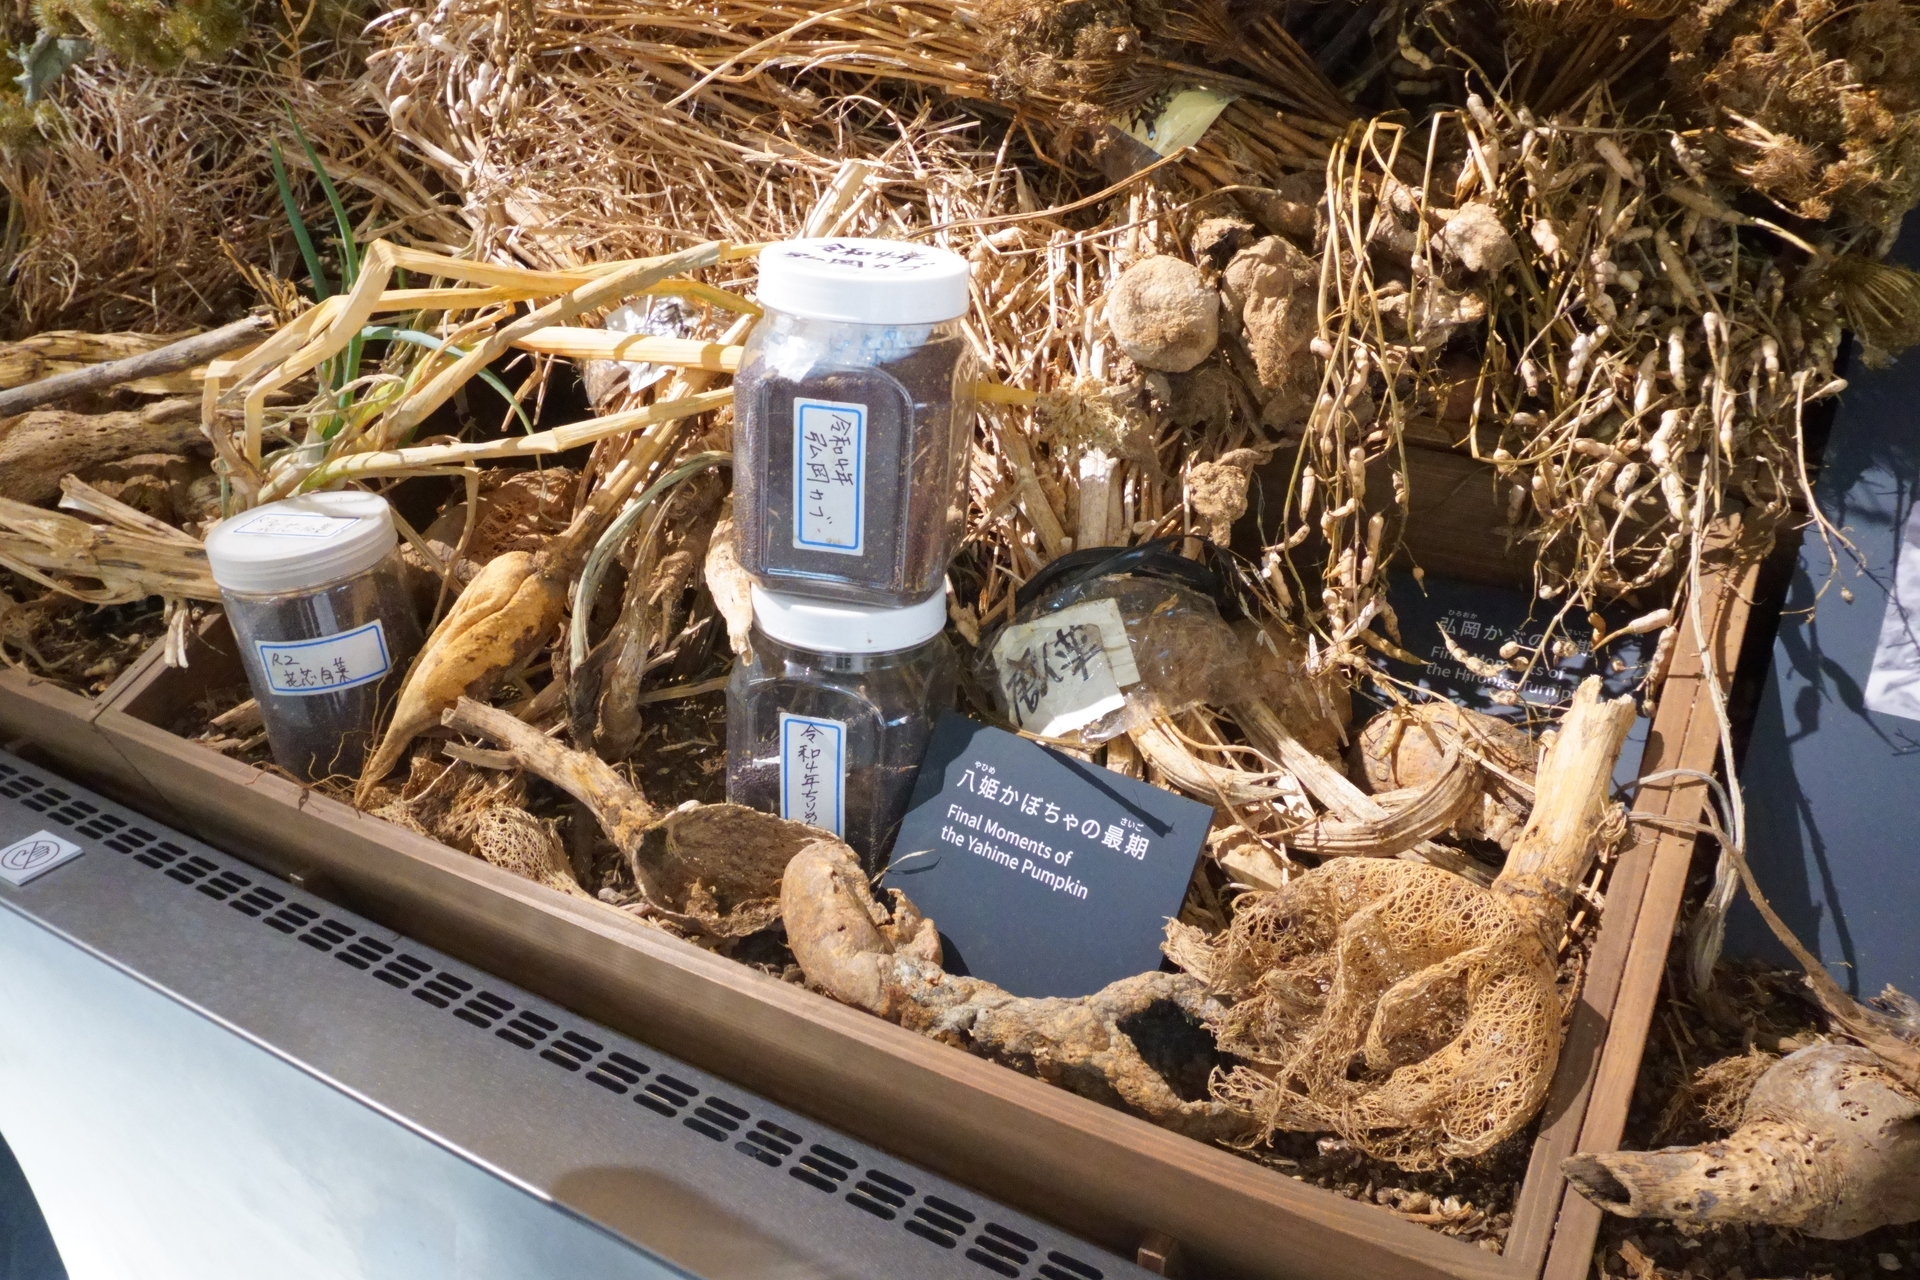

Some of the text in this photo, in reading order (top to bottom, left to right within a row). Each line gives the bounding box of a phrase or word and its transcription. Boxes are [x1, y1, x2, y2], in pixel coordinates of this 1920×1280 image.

[1438, 616, 1595, 658] 弘岡かぶの期
[1426, 662, 1451, 678] the
[1548, 667, 1566, 680] of
[974, 760, 996, 775] やひめ
[956, 768, 1150, 861] 八姫かぼちゃの最期
[1120, 816, 1144, 832] さいご
[947, 803, 1073, 867] Final Moments of
[941, 825, 1089, 899] the Yahime Pumpkin
